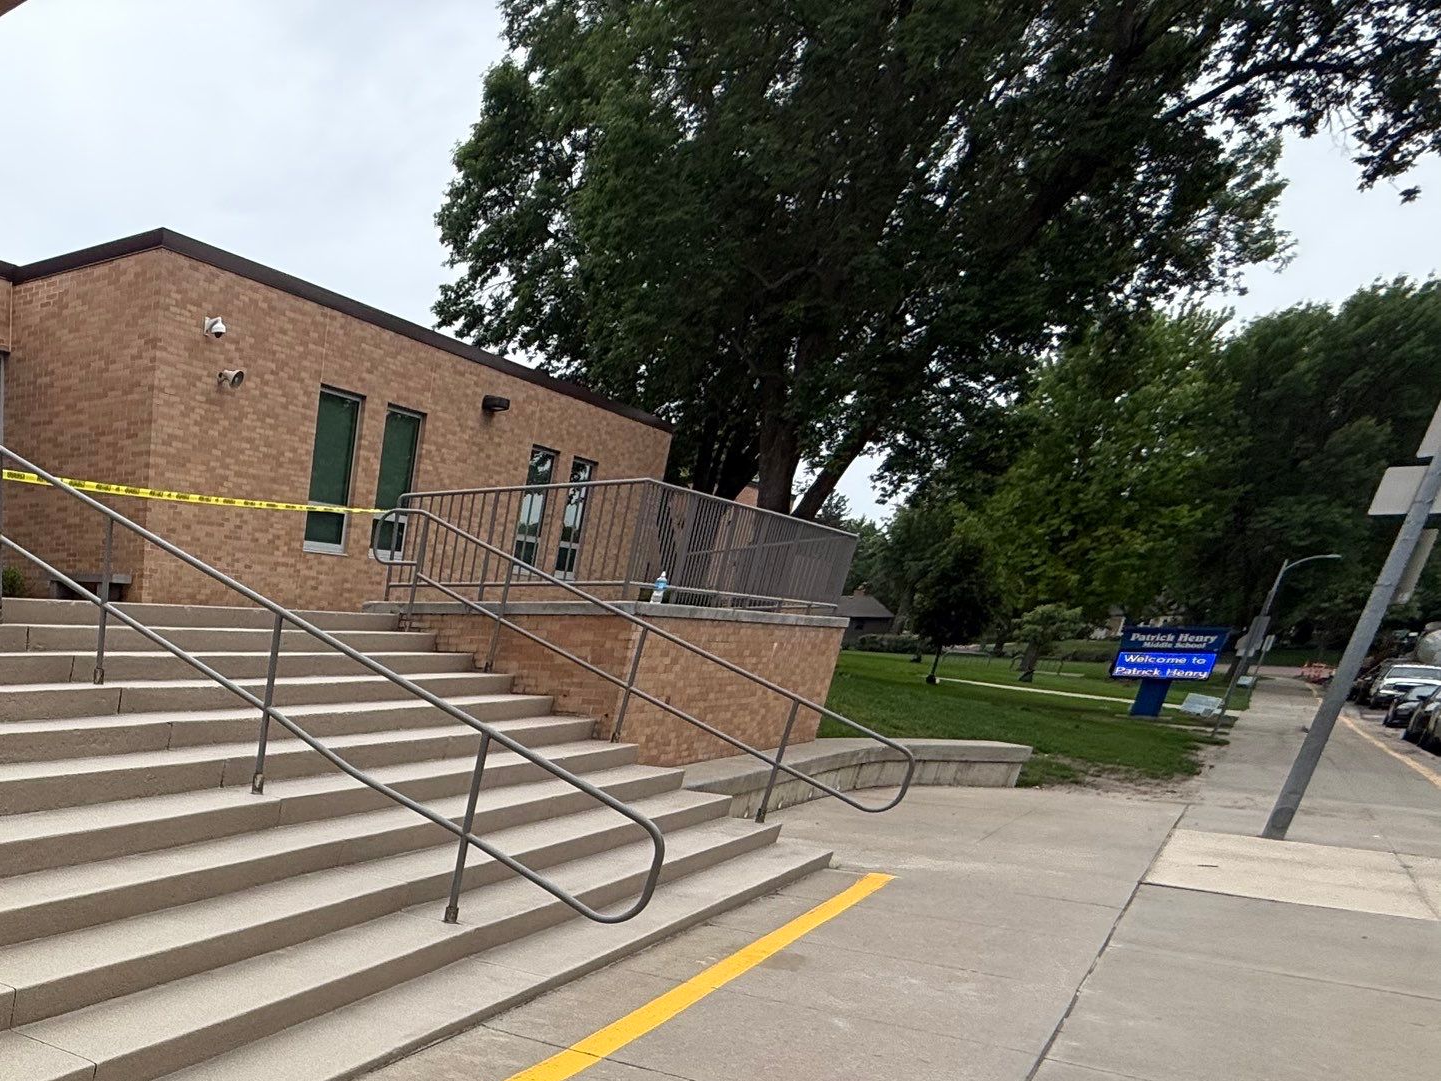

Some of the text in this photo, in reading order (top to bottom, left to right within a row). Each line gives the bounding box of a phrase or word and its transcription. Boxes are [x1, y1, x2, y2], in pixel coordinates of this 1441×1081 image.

[1130, 633, 1218, 643] Patrick Henry
[1124, 655, 1207, 665] Welcome to
[1114, 667, 1208, 679] Patrick Henry
